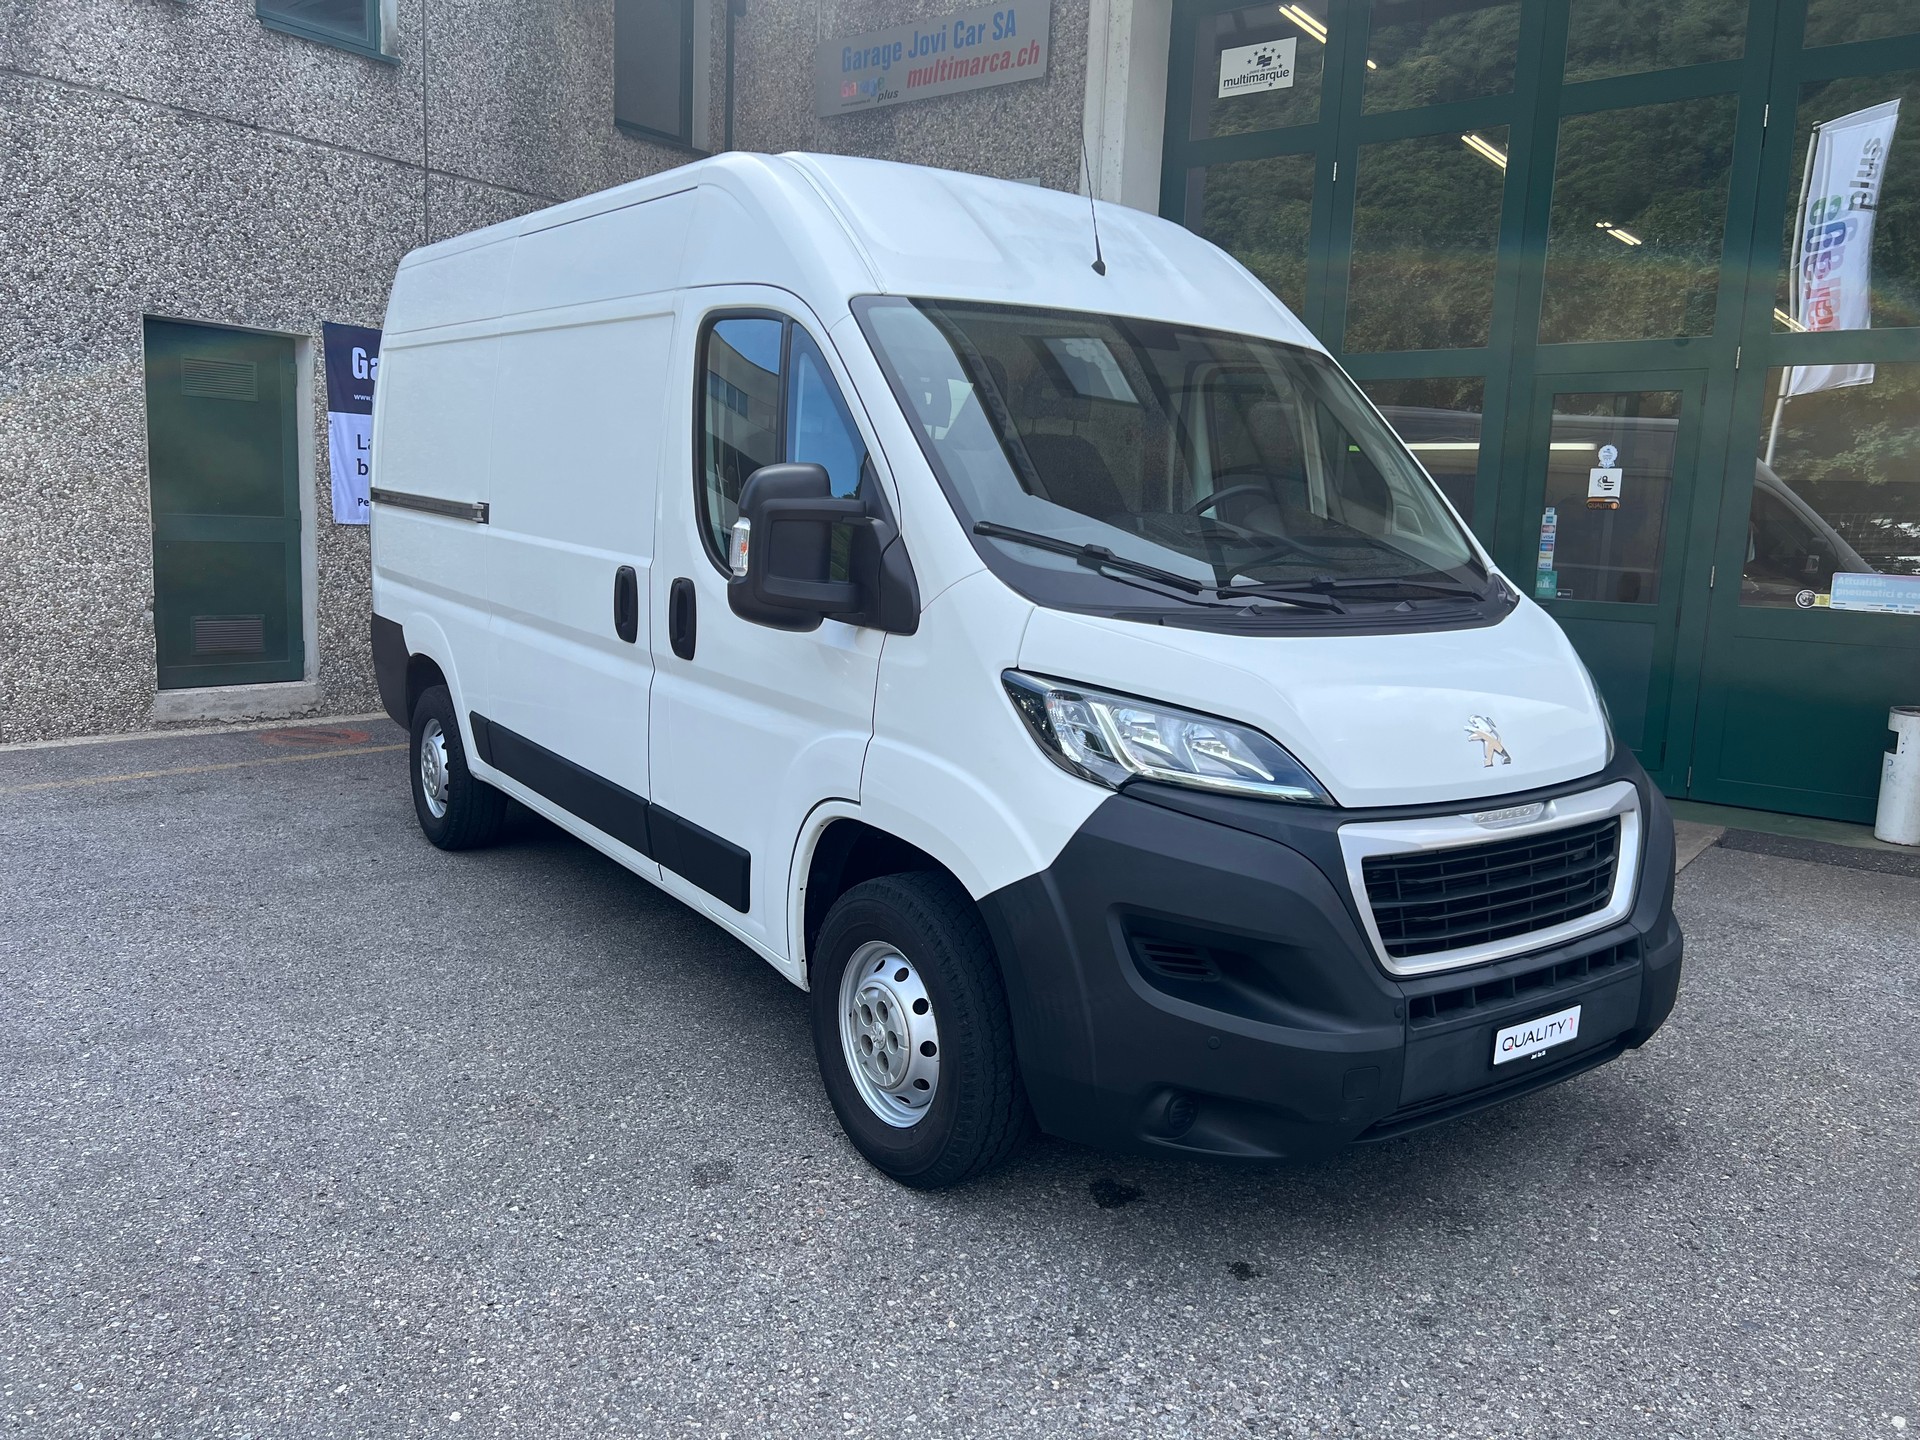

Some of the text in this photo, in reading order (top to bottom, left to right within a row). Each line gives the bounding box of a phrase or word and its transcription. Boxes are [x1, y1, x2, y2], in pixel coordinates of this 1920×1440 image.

[842, 9, 1016, 73] Garage Jovi Car SA
[906, 39, 1040, 89] multimarca.ch
[1223, 69, 1290, 87] multimarque
[877, 90, 899, 103] plus
[1848, 136, 1884, 213] plus
[1836, 587, 1894, 599] pneumatici
[1478, 805, 1538, 822] PEUGEOT
[1502, 1019, 1567, 1051] QUALITY
